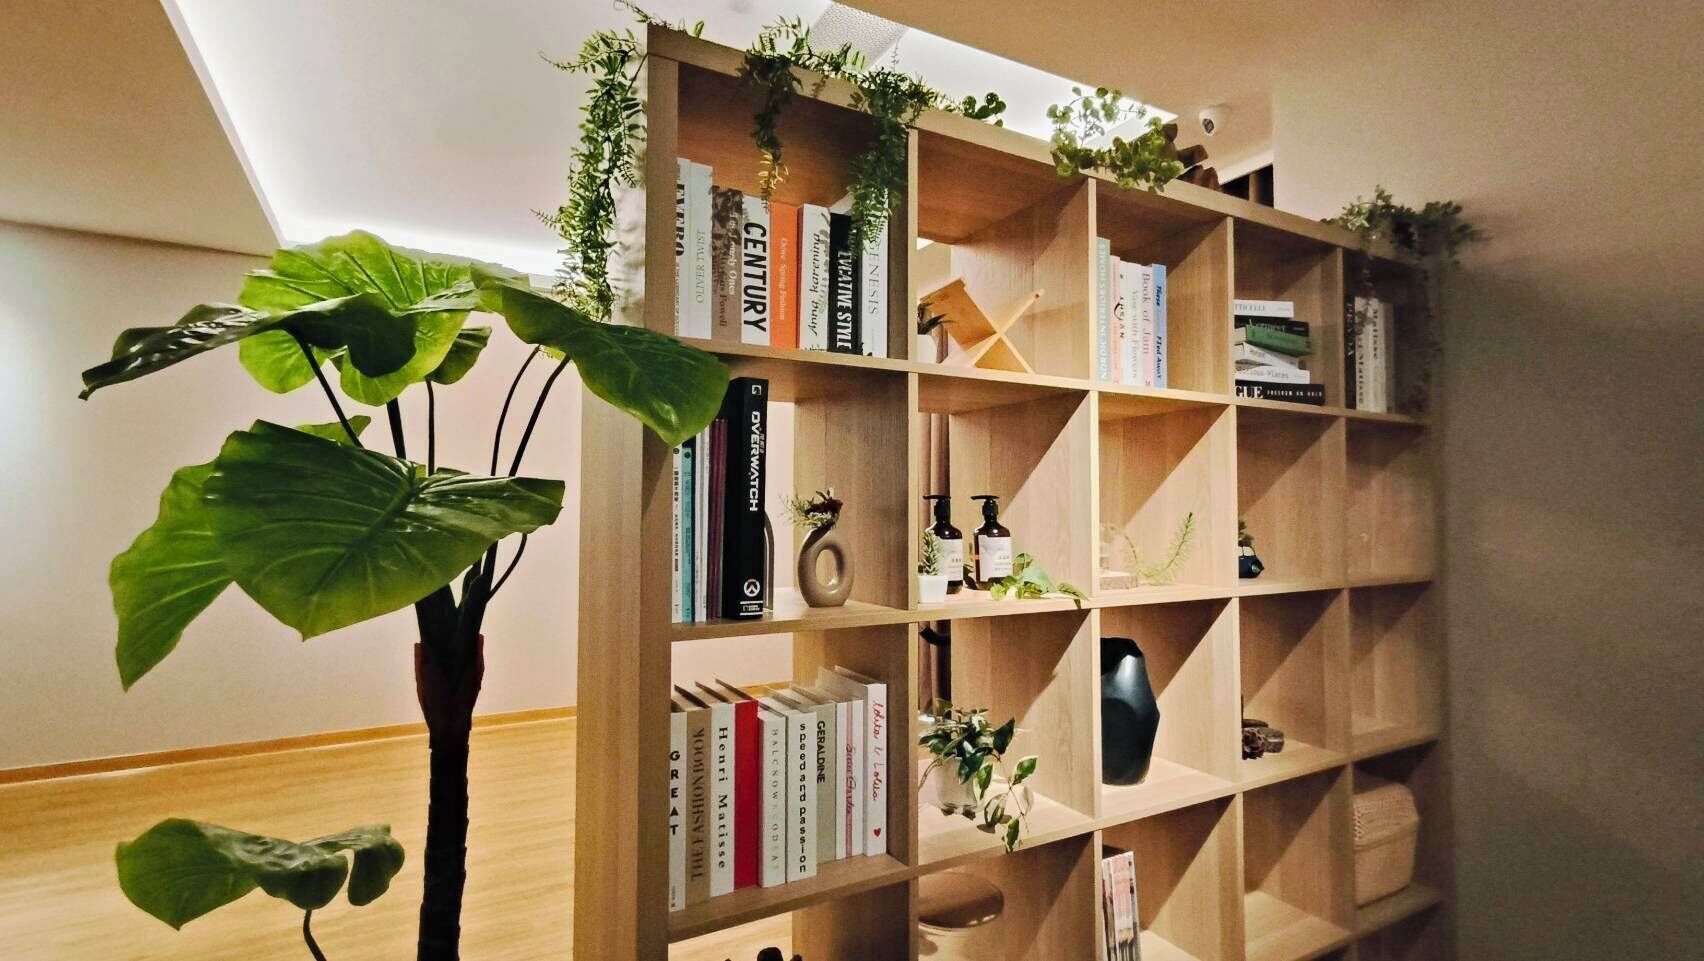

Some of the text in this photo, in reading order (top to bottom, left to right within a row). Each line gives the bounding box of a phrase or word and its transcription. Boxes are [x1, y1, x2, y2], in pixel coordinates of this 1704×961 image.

[695, 229, 706, 304] OLIVER TWIST
[743, 222, 767, 333] CENTURY
[867, 240, 881, 316] GENESIS
[807, 301, 818, 336] Anna
[836, 311, 852, 349] STYLE
[1142, 272, 1151, 355] Book of Jam
[749, 411, 761, 512] OVERWATCH
[816, 720, 826, 784] GERALDINE
[669, 750, 681, 836] GREAT
[718, 727, 728, 869] Henri Matisse
